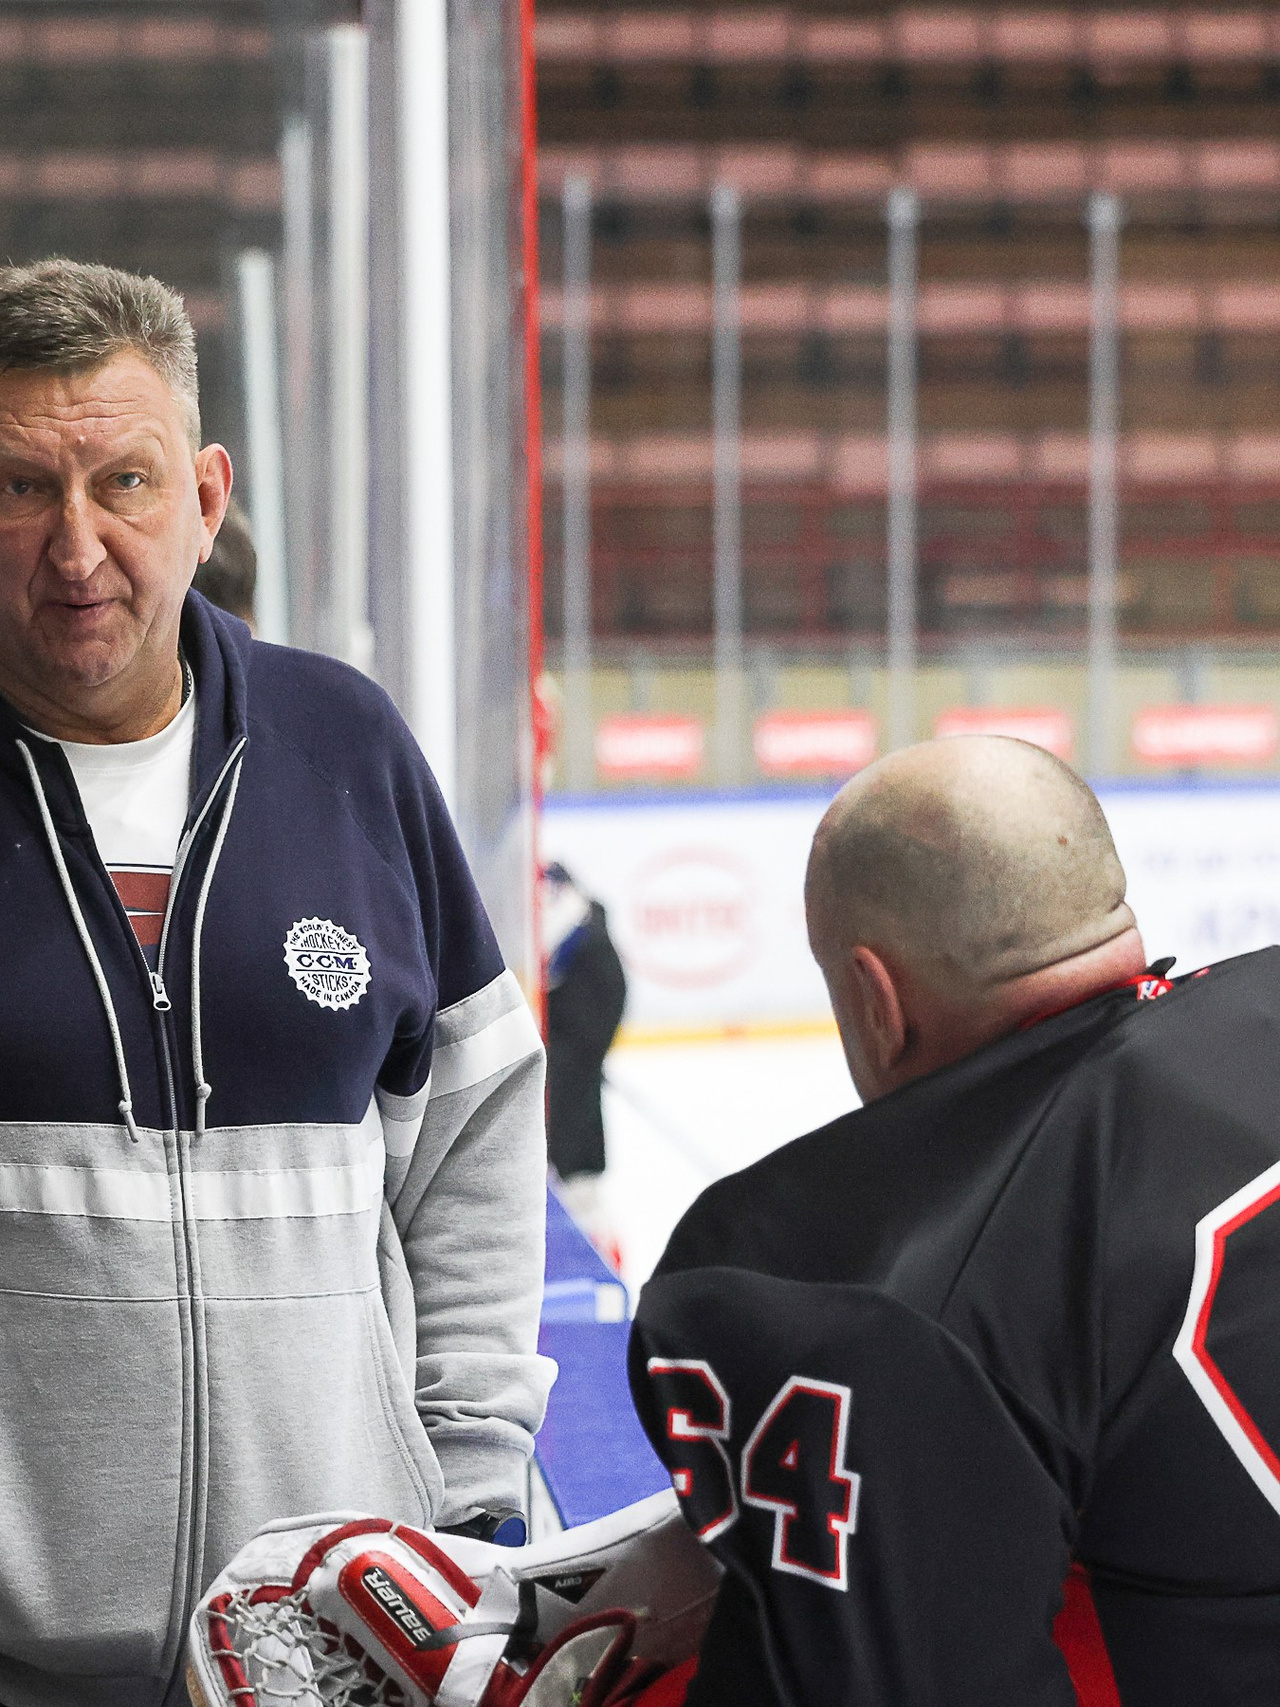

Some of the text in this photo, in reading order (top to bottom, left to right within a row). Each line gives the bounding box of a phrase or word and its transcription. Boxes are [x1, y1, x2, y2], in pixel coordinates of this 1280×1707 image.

[332, 929, 356, 950] FINEST
[299, 976, 361, 1003] MADE IN CANADA
[647, 1357, 862, 1593] 64
